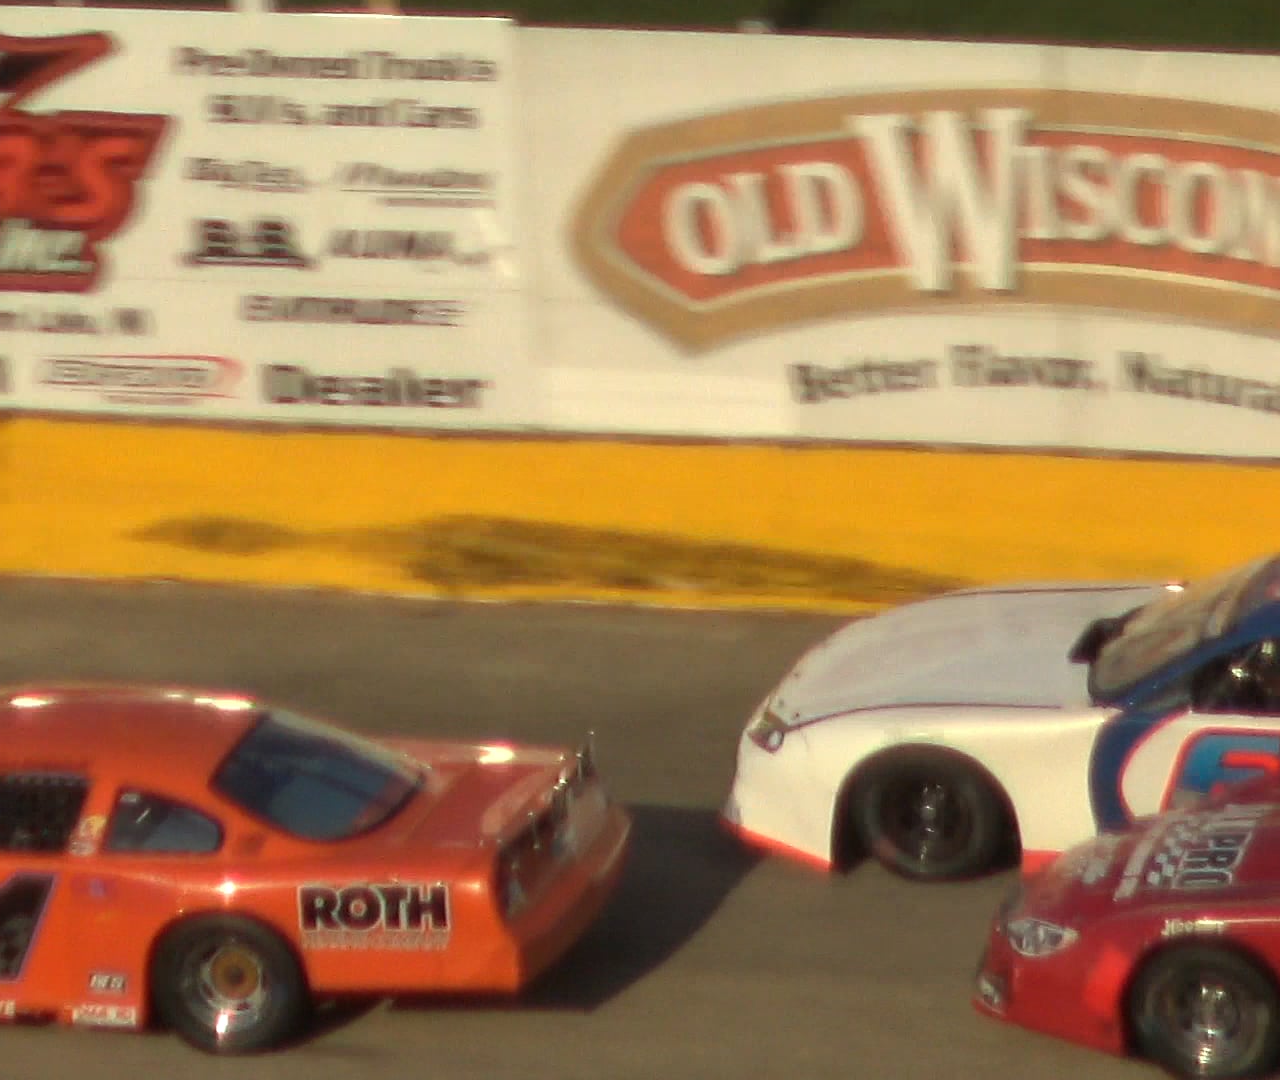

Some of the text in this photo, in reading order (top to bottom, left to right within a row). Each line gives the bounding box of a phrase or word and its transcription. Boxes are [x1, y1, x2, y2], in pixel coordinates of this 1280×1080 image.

[662, 160, 867, 277] OLD
[261, 364, 486, 408] Dealer
[788, 360, 939, 405] Better
[296, 881, 452, 933] ROTH
